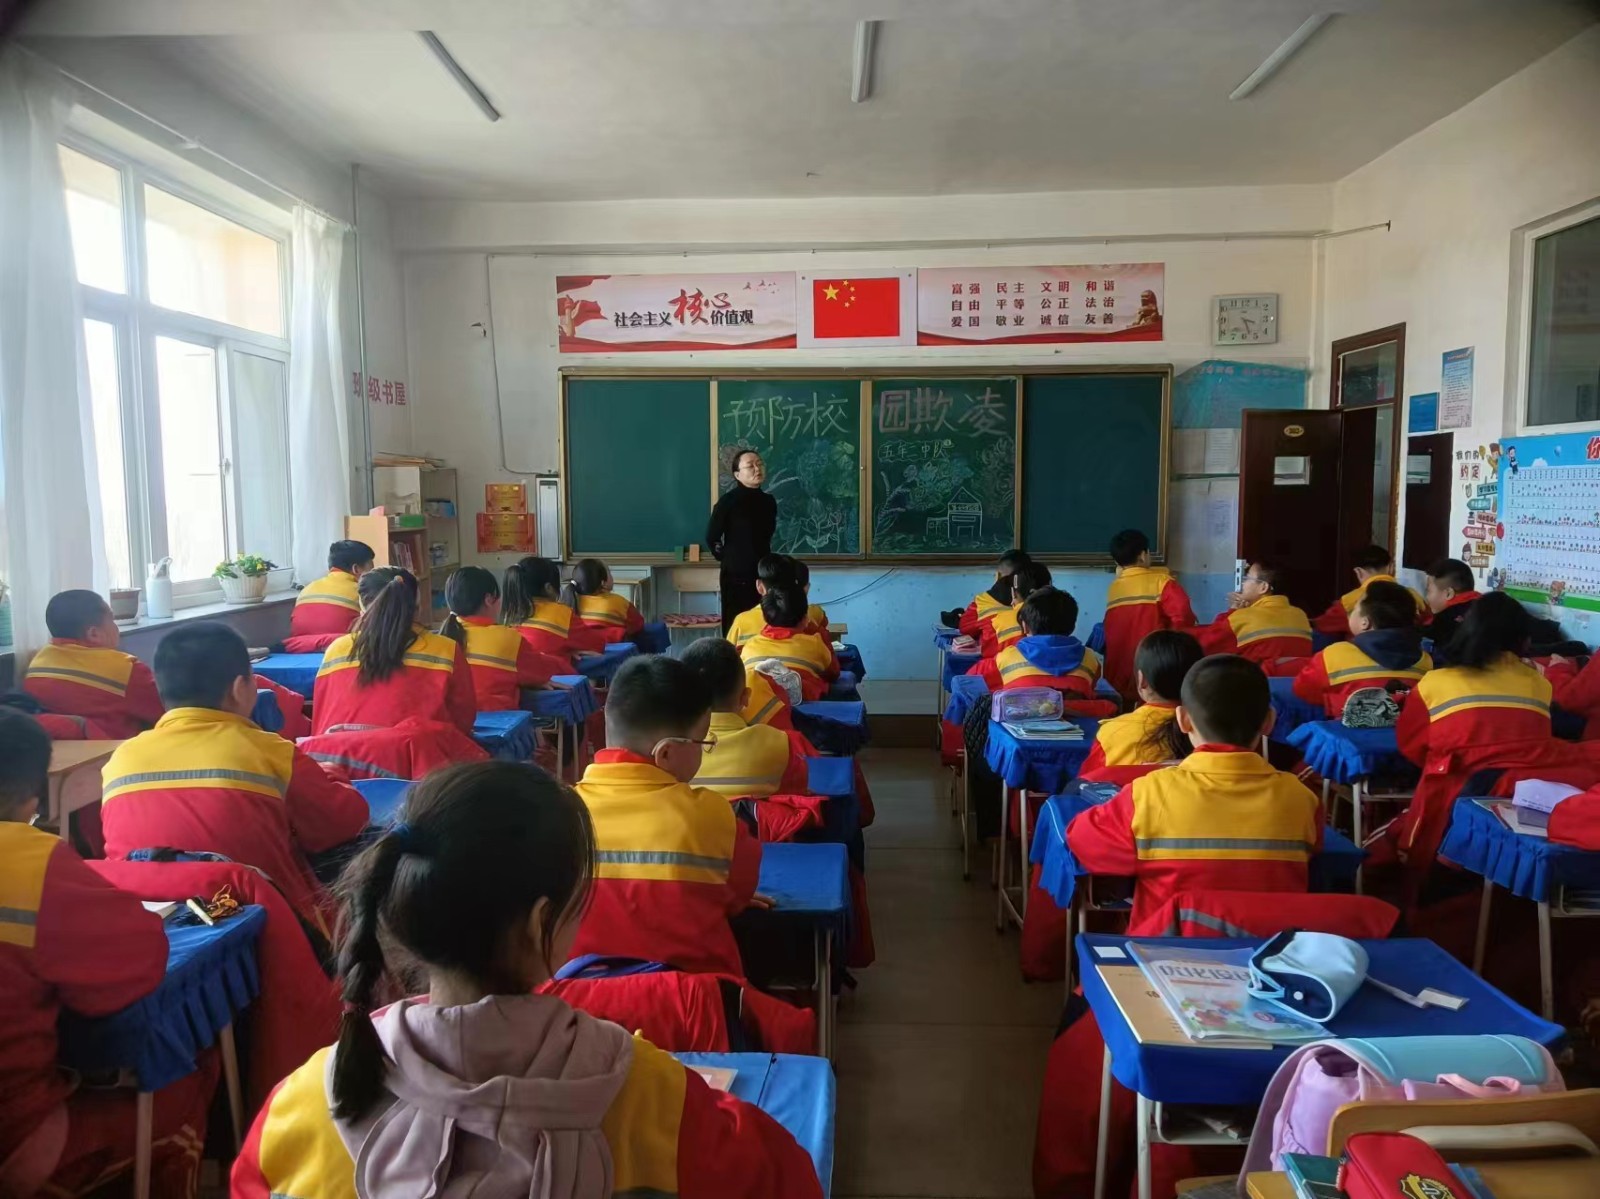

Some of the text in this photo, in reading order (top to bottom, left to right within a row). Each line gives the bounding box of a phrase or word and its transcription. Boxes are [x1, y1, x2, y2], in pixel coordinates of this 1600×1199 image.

[951, 280, 1115, 295] 富强 民主 文明 和谐
[614, 287, 754, 327] 社会主义核心价值观
[951, 297, 1115, 312] 自由 平等 公正 法治
[951, 313, 1114, 328] 爱国 敬业 诚信 友善
[723, 387, 1008, 446] 预防校 园欺凌
